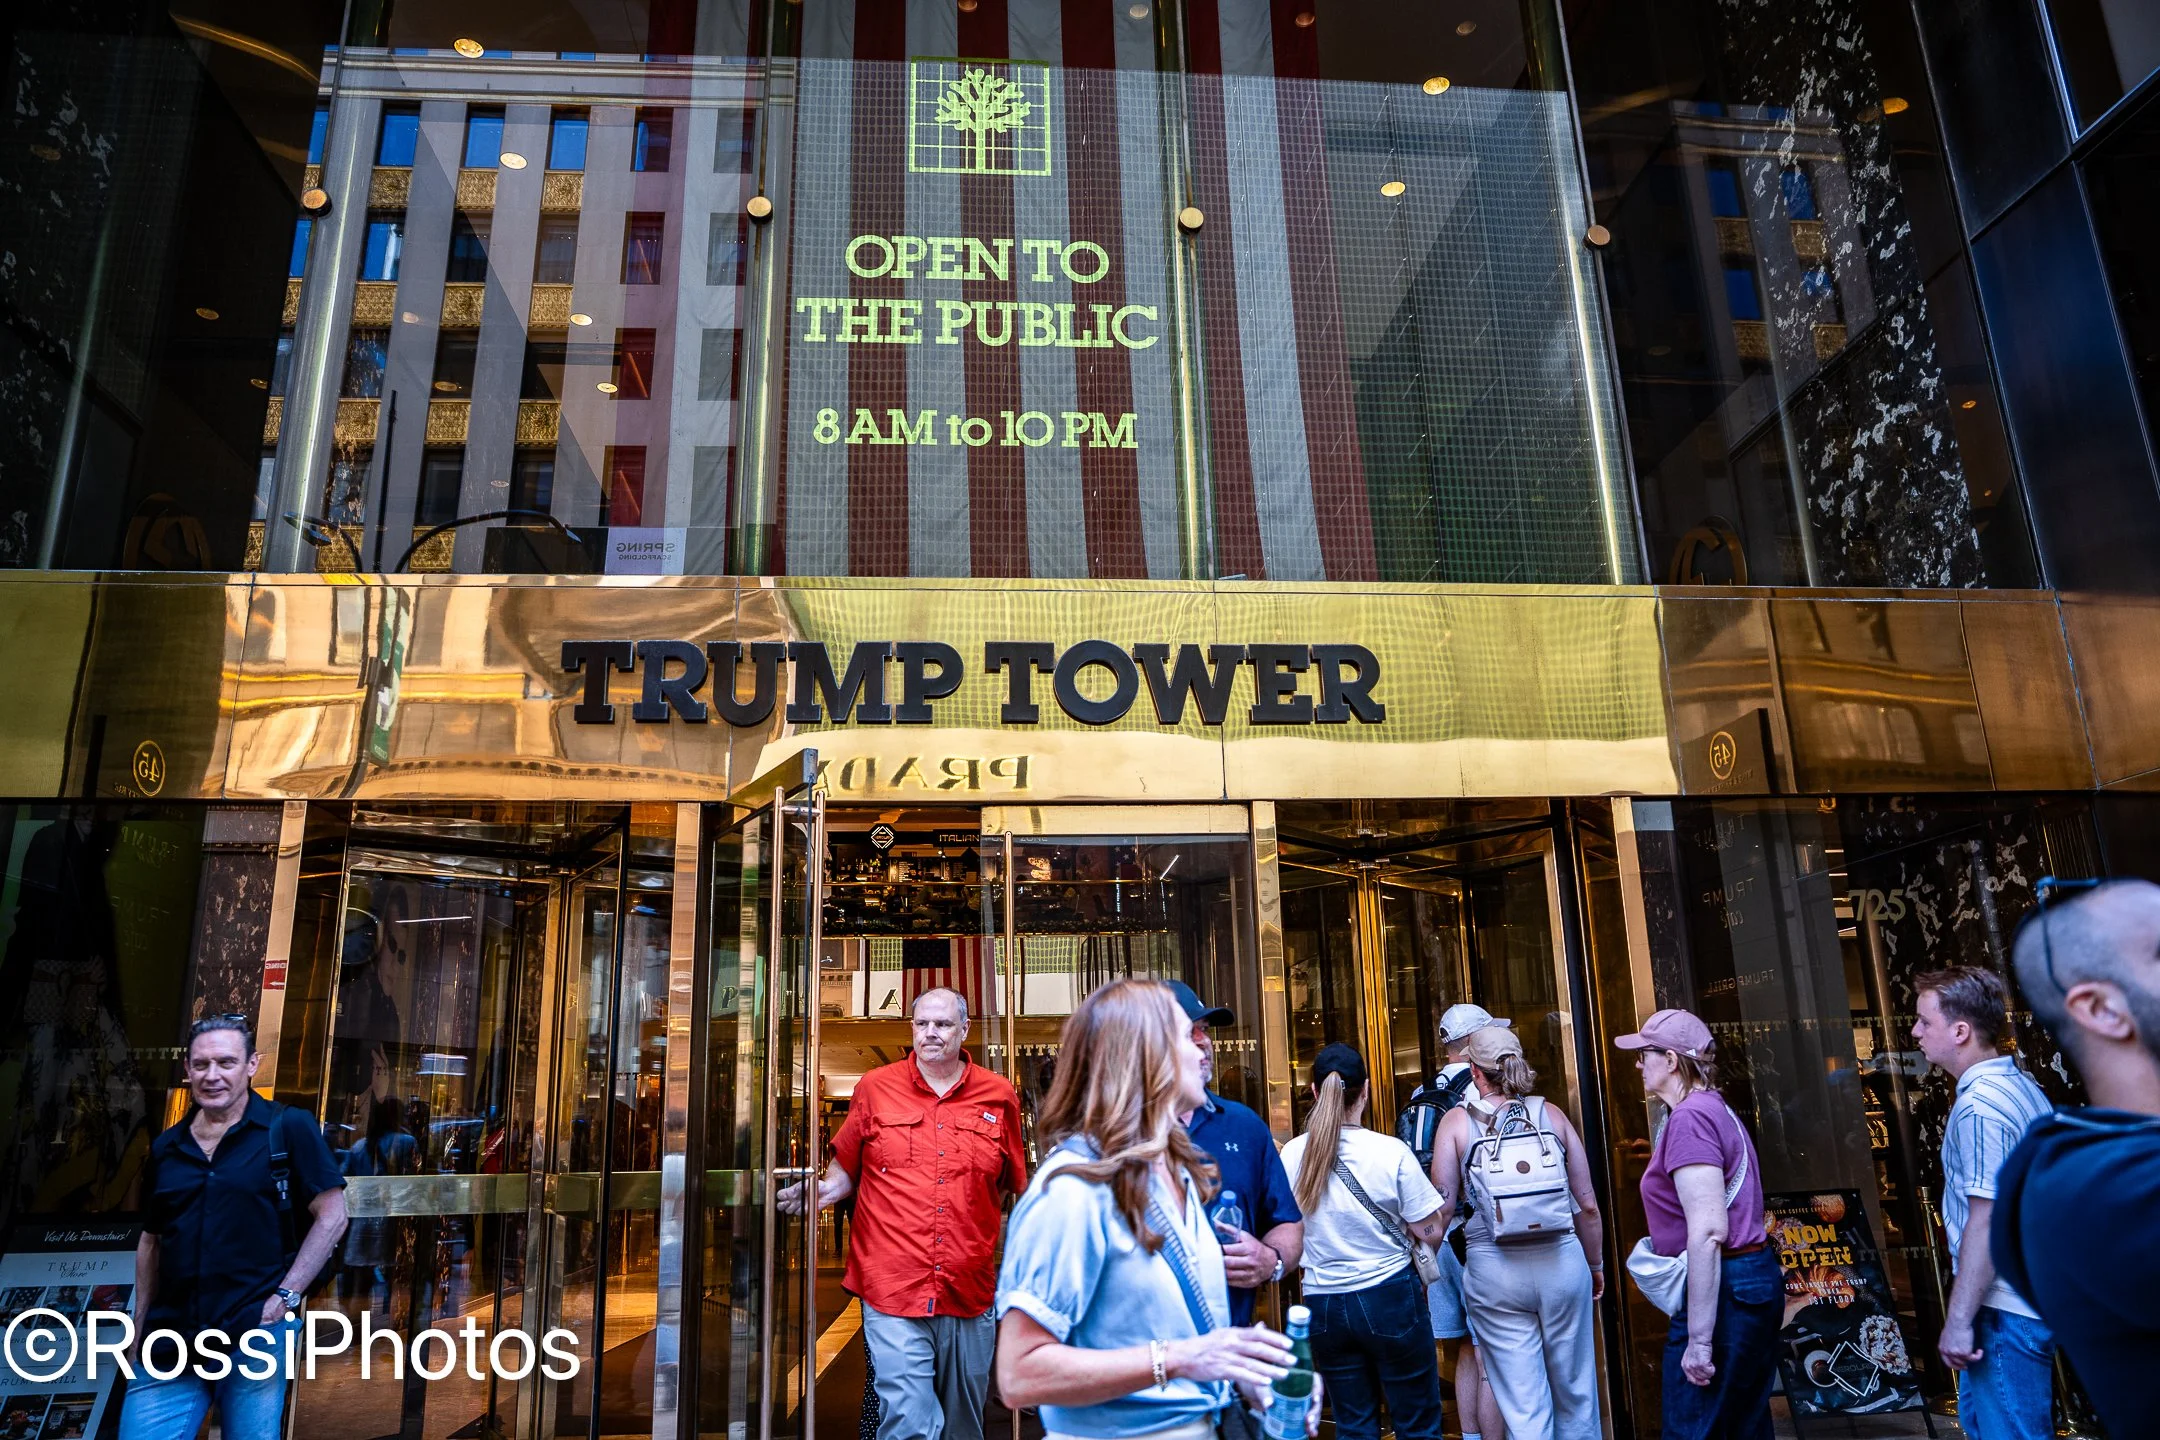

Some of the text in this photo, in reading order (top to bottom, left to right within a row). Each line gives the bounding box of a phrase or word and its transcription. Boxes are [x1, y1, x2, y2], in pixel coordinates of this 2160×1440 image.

[845, 234, 1110, 284] OPEN TO
[796, 297, 1160, 350] THE PUBLIC
[812, 407, 1139, 449] 8 AM to 10 PM
[561, 640, 1386, 728] TRUMP TOWER
[939, 834, 980, 842] ITALIAN
[1848, 888, 1907, 924] 725
[44, 1228, 132, 1243] Visit Us Downstairs!
[1782, 1224, 1837, 1245] NOW
[48, 1261, 109, 1272] TRUMP
[1781, 1246, 1854, 1269] OPEN
[1828, 1294, 1855, 1304] FLOOR
